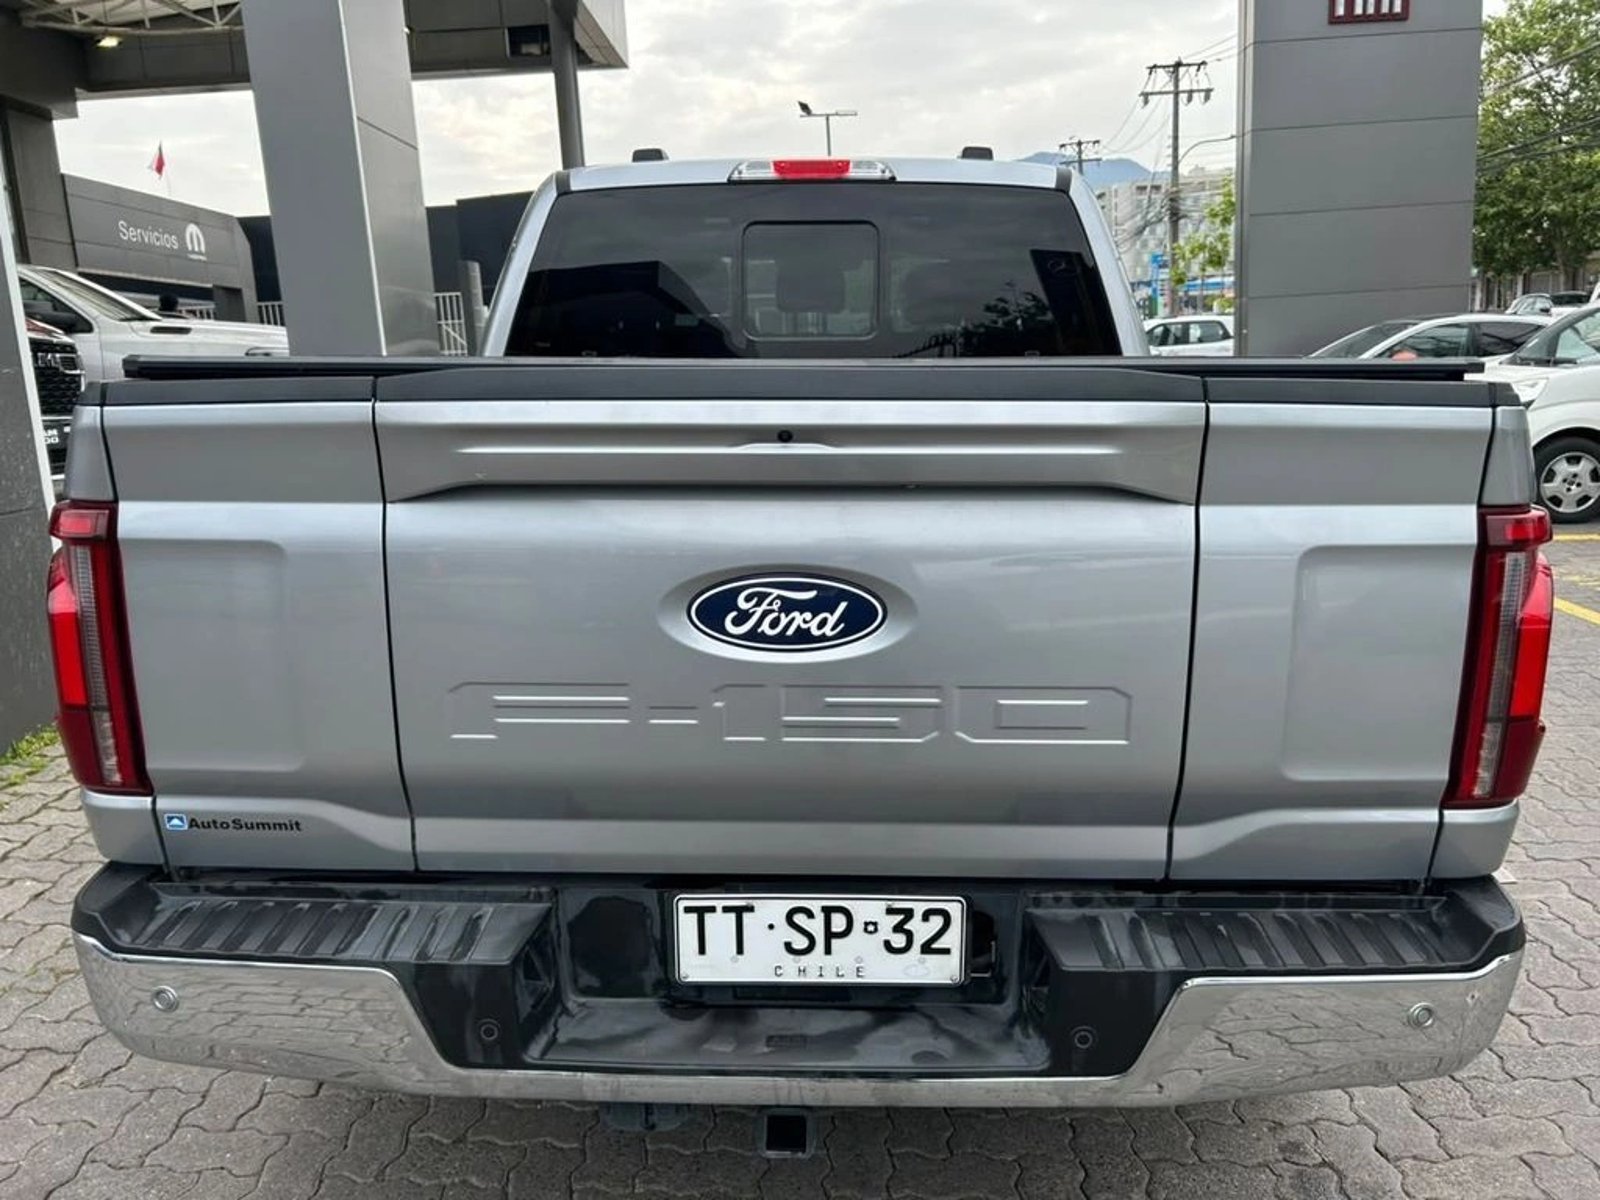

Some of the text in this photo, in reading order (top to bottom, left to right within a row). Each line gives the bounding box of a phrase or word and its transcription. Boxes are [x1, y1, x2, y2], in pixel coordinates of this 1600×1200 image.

[118, 220, 179, 250] Servicios
[724, 587, 848, 637] Ford
[448, 681, 1133, 745] F-150
[188, 817, 302, 832] AutoSummit
[774, 965, 865, 978] CHILE
